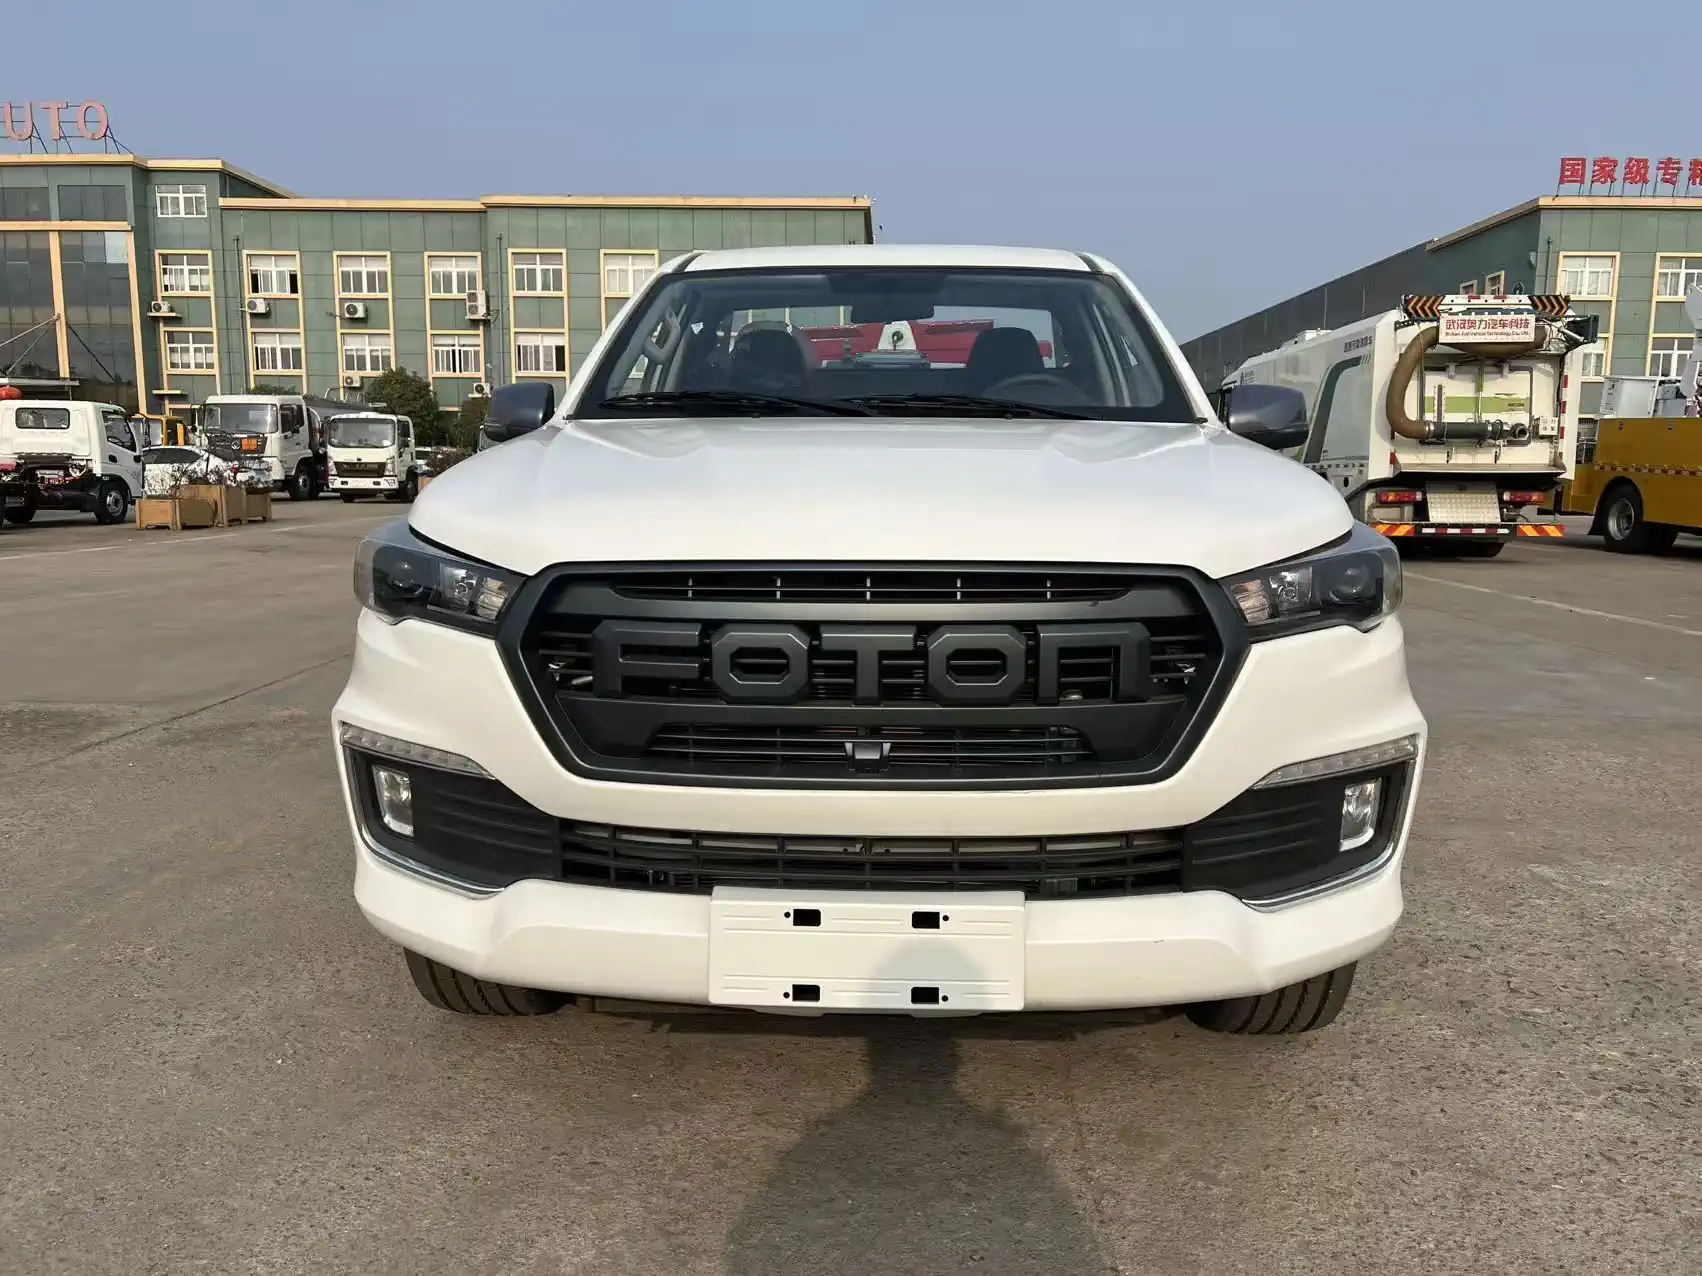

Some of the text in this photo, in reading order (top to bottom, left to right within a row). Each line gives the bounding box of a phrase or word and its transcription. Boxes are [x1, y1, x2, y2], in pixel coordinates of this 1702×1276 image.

[1445, 318, 1530, 330] 武汉奥力汽车科技
[593, 621, 1151, 706] FOTON
